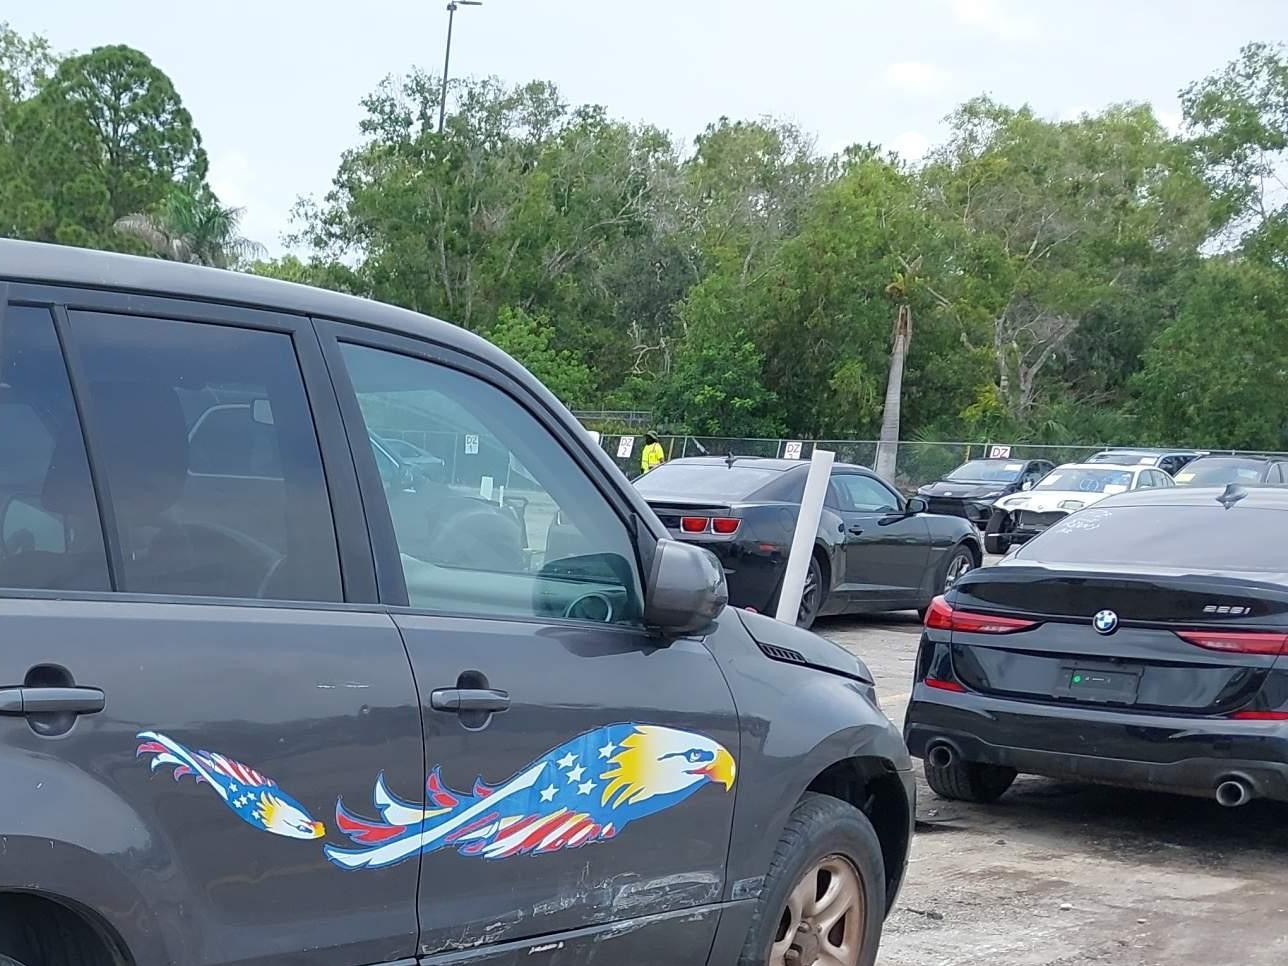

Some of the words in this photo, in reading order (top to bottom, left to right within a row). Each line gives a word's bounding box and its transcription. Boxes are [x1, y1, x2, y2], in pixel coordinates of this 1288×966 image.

[621, 438, 633, 447] DZ
[787, 443, 800, 453] DZ
[992, 447, 1008, 457] DZ
